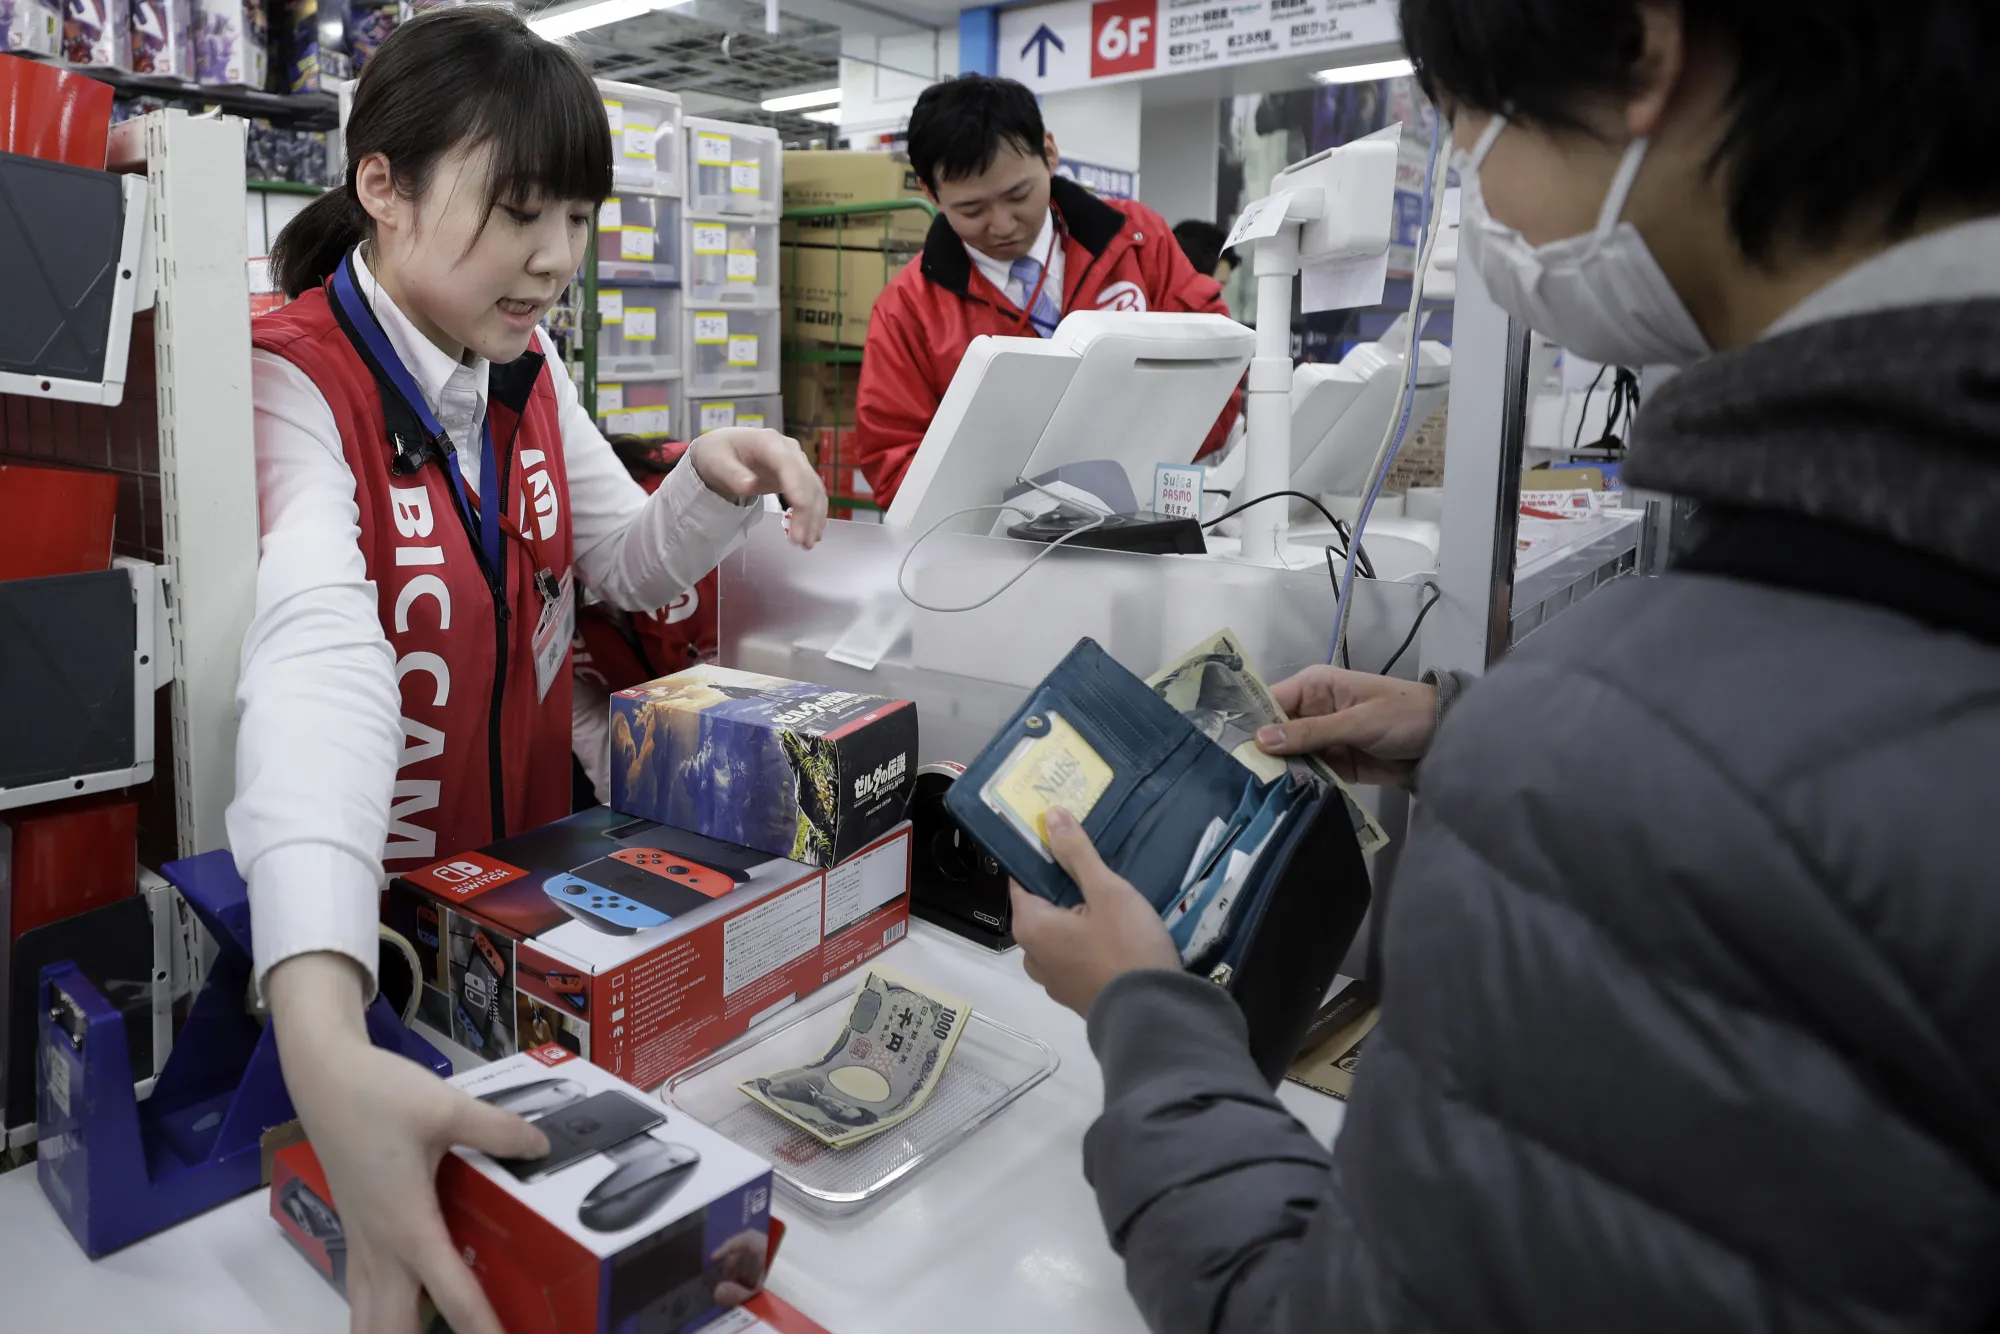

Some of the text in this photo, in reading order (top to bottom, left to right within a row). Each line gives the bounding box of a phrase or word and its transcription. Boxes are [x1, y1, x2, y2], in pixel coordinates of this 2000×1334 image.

[1098, 16, 1151, 60] 6F
[854, 751, 906, 799] ゼルダの伝説
[451, 868, 502, 891] NINTENDO
[456, 870, 512, 895] SWITCH
[491, 976, 500, 1024] SWITCH
[885, 1007, 914, 1053] 千円
[933, 1006, 957, 1041] 1000
